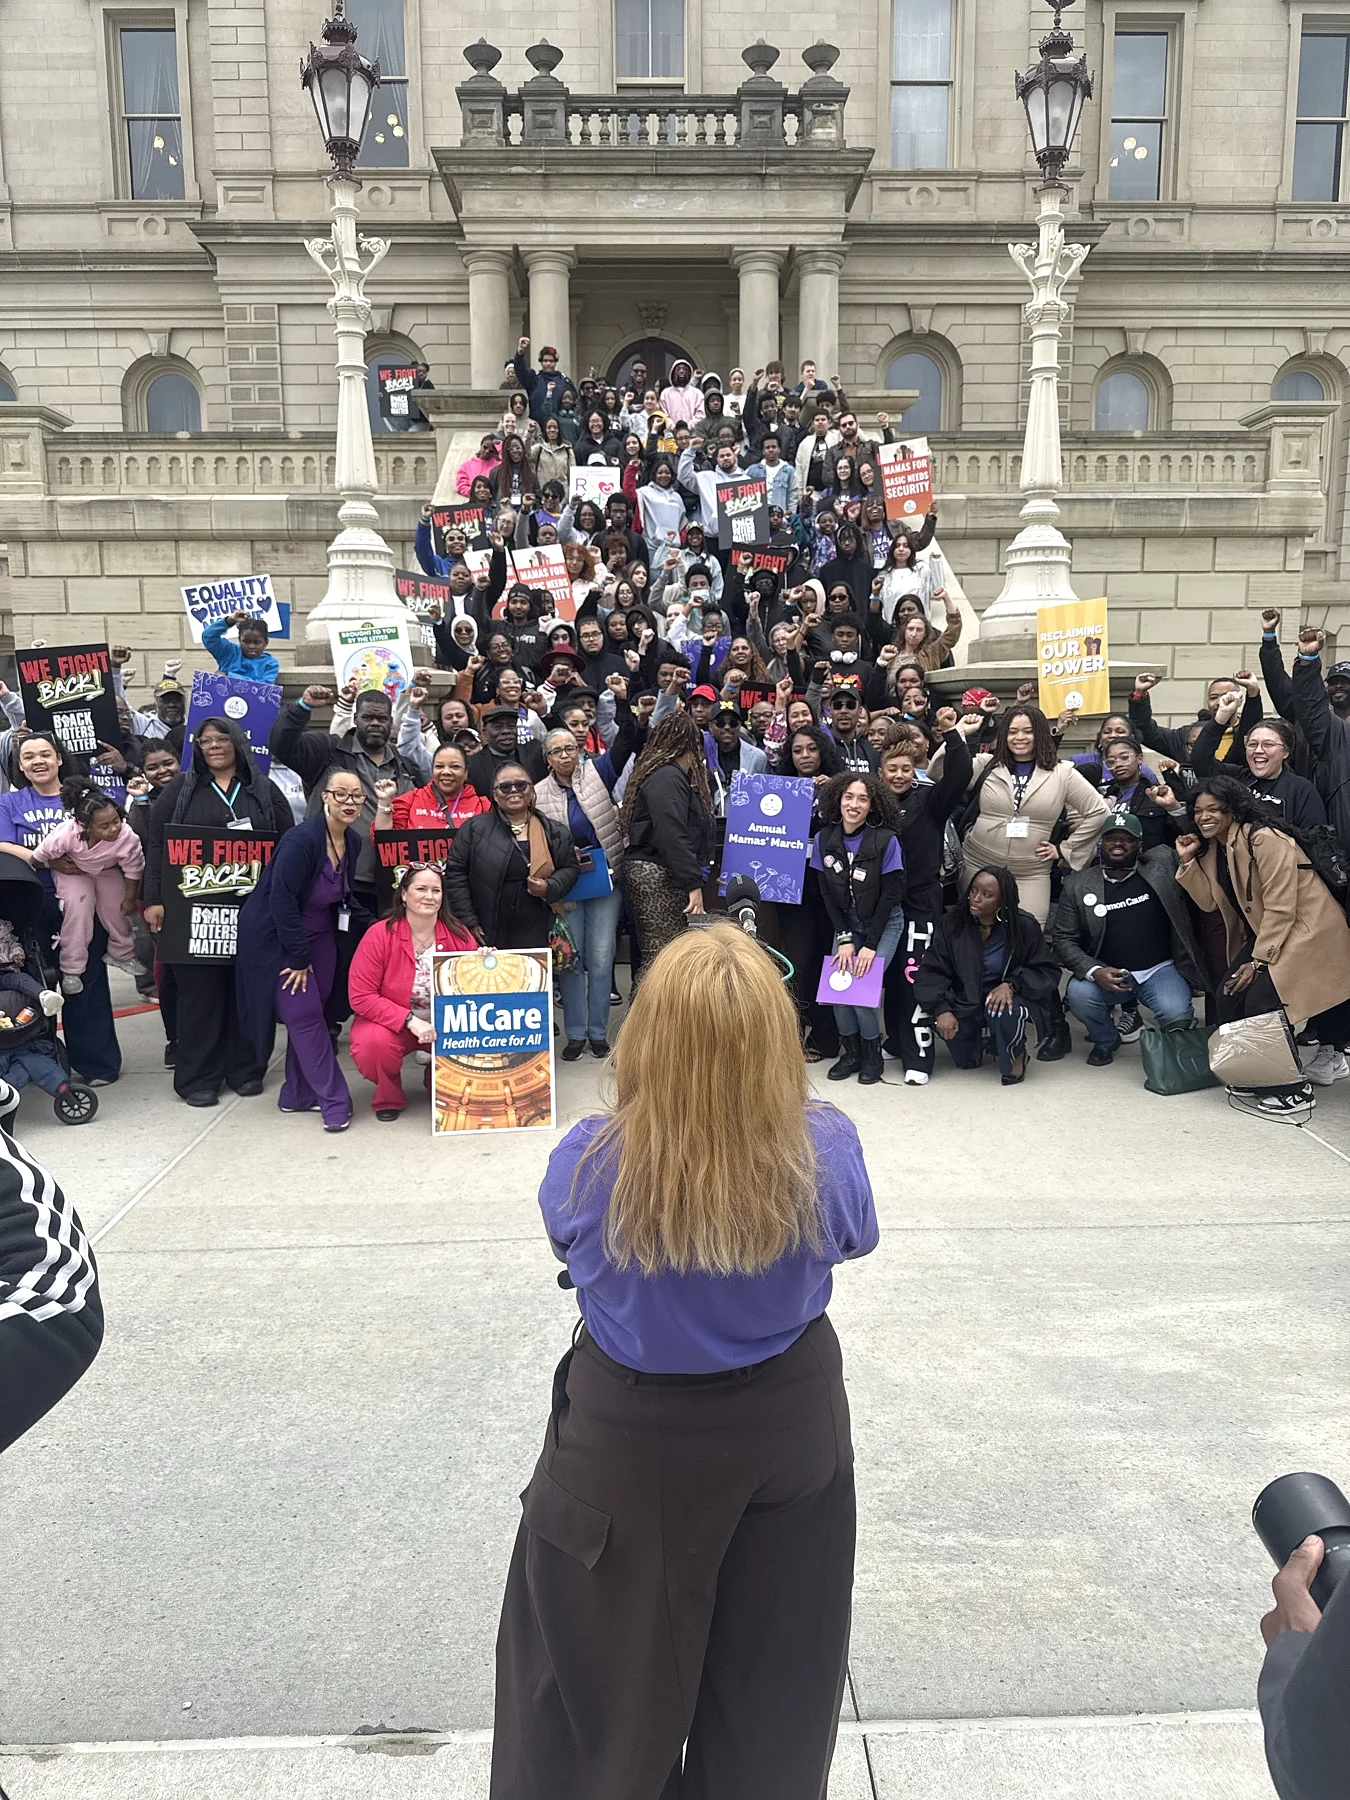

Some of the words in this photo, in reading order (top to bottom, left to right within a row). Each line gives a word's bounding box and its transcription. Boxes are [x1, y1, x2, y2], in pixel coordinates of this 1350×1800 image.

[380, 369, 392, 381] WE
[395, 368, 417, 379] FIGHT
[884, 462, 911, 475] MAMAS
[912, 459, 928, 470] FOR
[885, 476, 907, 487] BASIC
[907, 471, 929, 482] NEEDS
[717, 488, 733, 502] WE
[737, 481, 766, 498] FIGHT
[886, 481, 929, 498] SECURITY
[725, 492, 762, 514] BACK!
[433, 512, 451, 527] WE
[454, 507, 484, 524] FIGHT
[753, 553, 786, 573] FIGHT
[520, 568, 549, 580] MAMAS
[550, 566, 565, 576] FOR
[185, 576, 269, 606] EQUALITY
[397, 578, 415, 596] WE
[419, 581, 450, 602] FIGHT
[546, 578, 568, 588] NEEDS
[208, 596, 254, 618] HURTS
[341, 629, 372, 638] BROUGHT
[1040, 624, 1103, 643] RECLAIMING
[1041, 640, 1080, 660] OUR
[20, 658, 53, 684] WE
[57, 651, 109, 679] FIGHT
[1041, 655, 1106, 678] POWER
[38, 668, 105, 706] BACK!
[55, 725, 95, 741] VOTERS
[62, 738, 98, 753] ATTER
[251, 745, 269, 755] rch
[748, 822, 786, 835] Annual
[1114, 814, 1126, 826] LA
[728, 833, 769, 846] Mamas'
[770, 837, 804, 850] March
[167, 839, 203, 865] WE
[213, 840, 274, 866] FIGHT
[378, 842, 410, 867] WE
[417, 838, 453, 864] FIG
[180, 861, 261, 893] BACK!
[1125, 893, 1150, 906] Cause
[190, 924, 238, 940] VOTERS
[188, 938, 237, 955] MATTER
[443, 999, 542, 1034] MiCare
[443, 1036, 480, 1050] Health
[481, 1035, 508, 1049] Care
[508, 1034, 526, 1047] for
[526, 1034, 542, 1046] All
